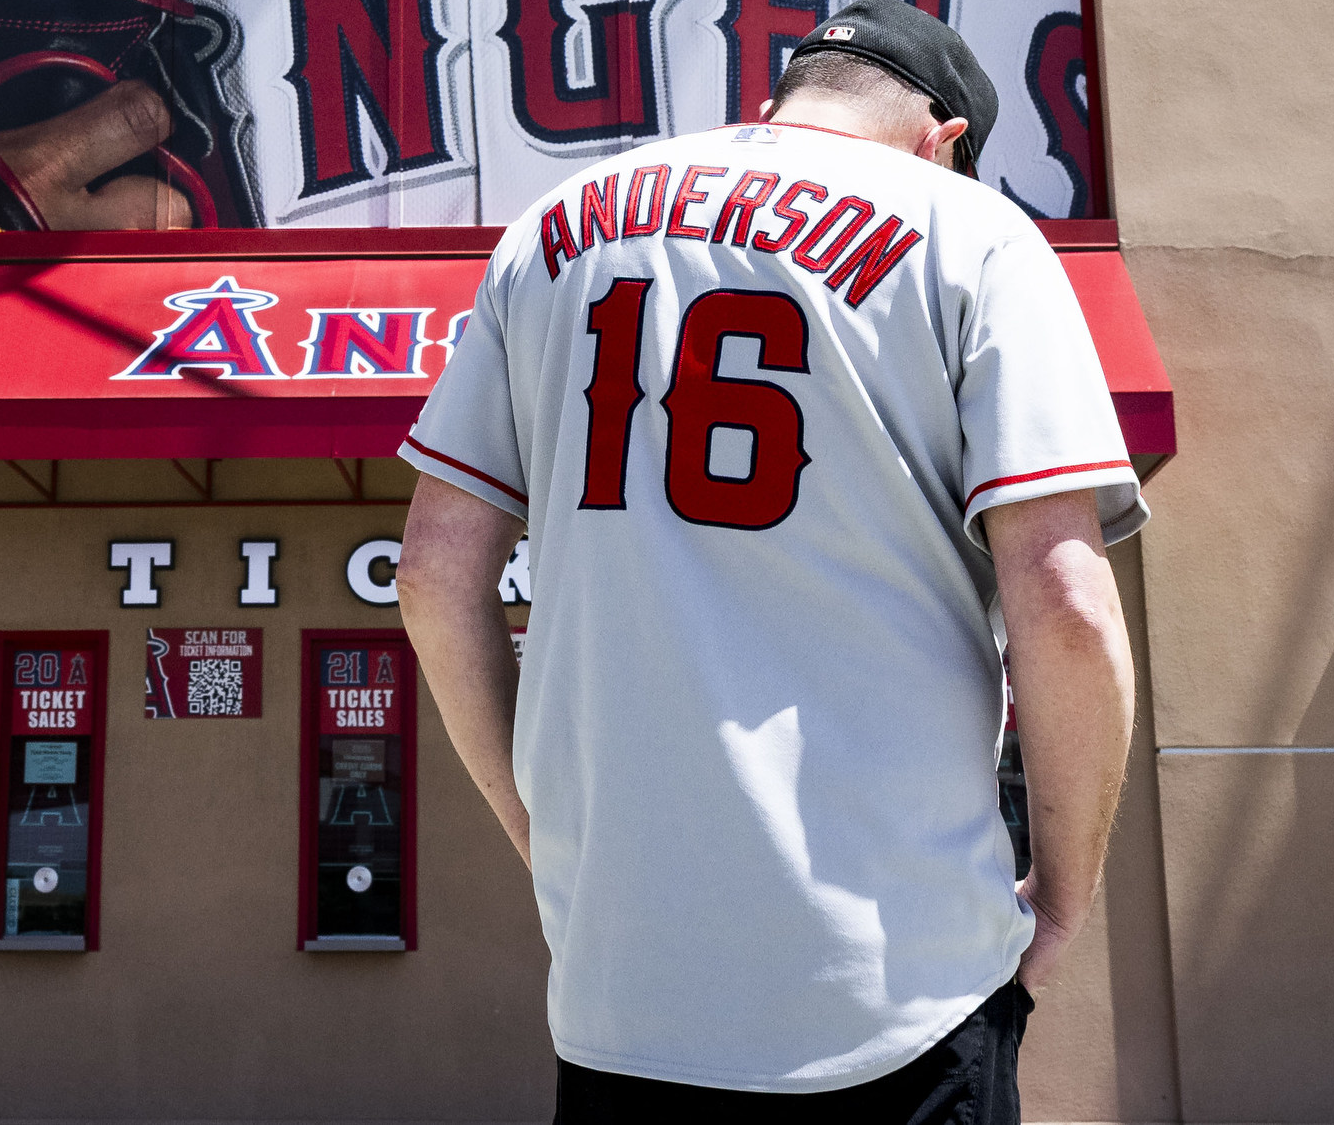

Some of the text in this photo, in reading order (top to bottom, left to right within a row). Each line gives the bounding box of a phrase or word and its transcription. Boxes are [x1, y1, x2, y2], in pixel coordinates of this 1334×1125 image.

[540, 163, 923, 310] ANDERSON
[578, 277, 813, 531] 16
[184, 631, 247, 645] SCAN FOR
[179, 644, 254, 657] TICKET INFORMATION
[15, 652, 59, 685] 20
[327, 651, 362, 684] 21
[20, 690, 86, 710] TICKET
[328, 689, 394, 709] TICKET
[28, 710, 76, 728] SALES
[336, 709, 385, 728] SALES
